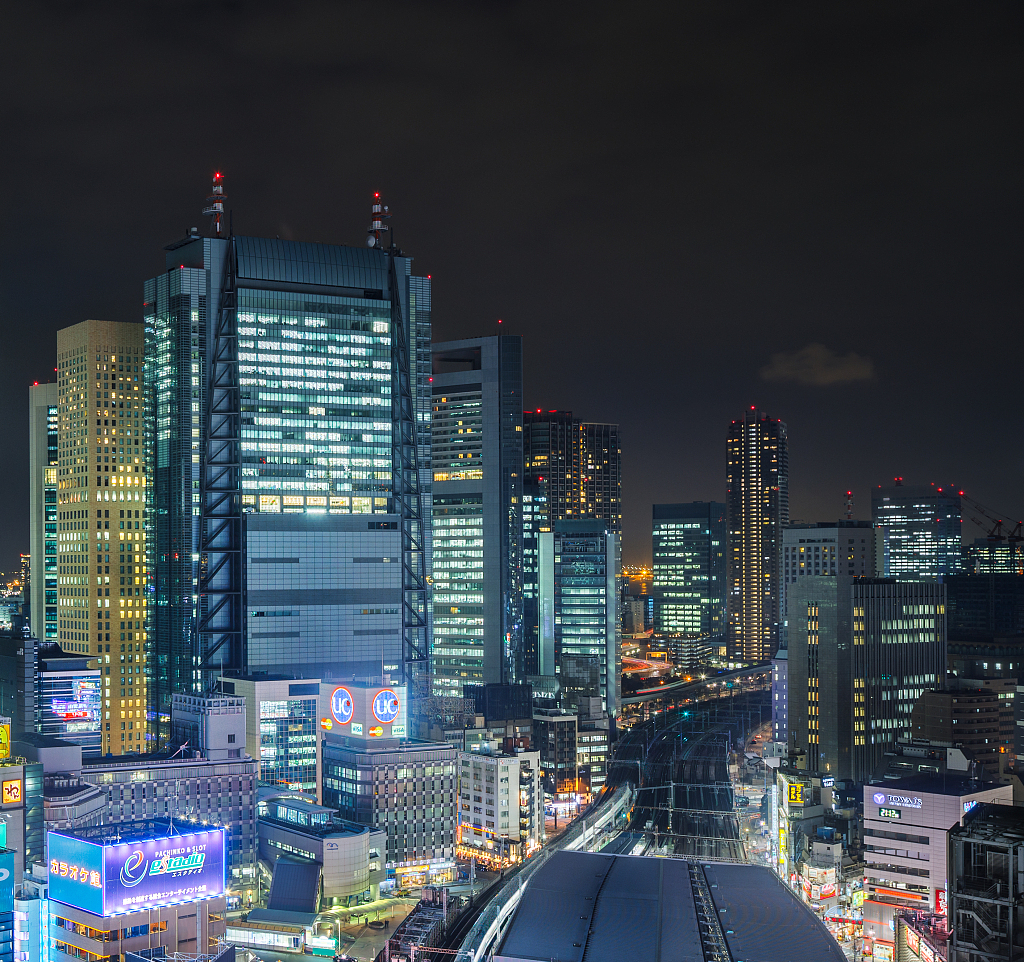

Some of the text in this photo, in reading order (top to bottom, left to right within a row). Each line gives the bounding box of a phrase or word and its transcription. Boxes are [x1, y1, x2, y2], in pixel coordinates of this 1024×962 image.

[332, 697, 351, 715] UC
[376, 698, 398, 715] UC
[155, 847, 186, 858] PACHINKO
[192, 844, 206, 852] SLOT
[50, 859, 102, 887] カラオケ館
